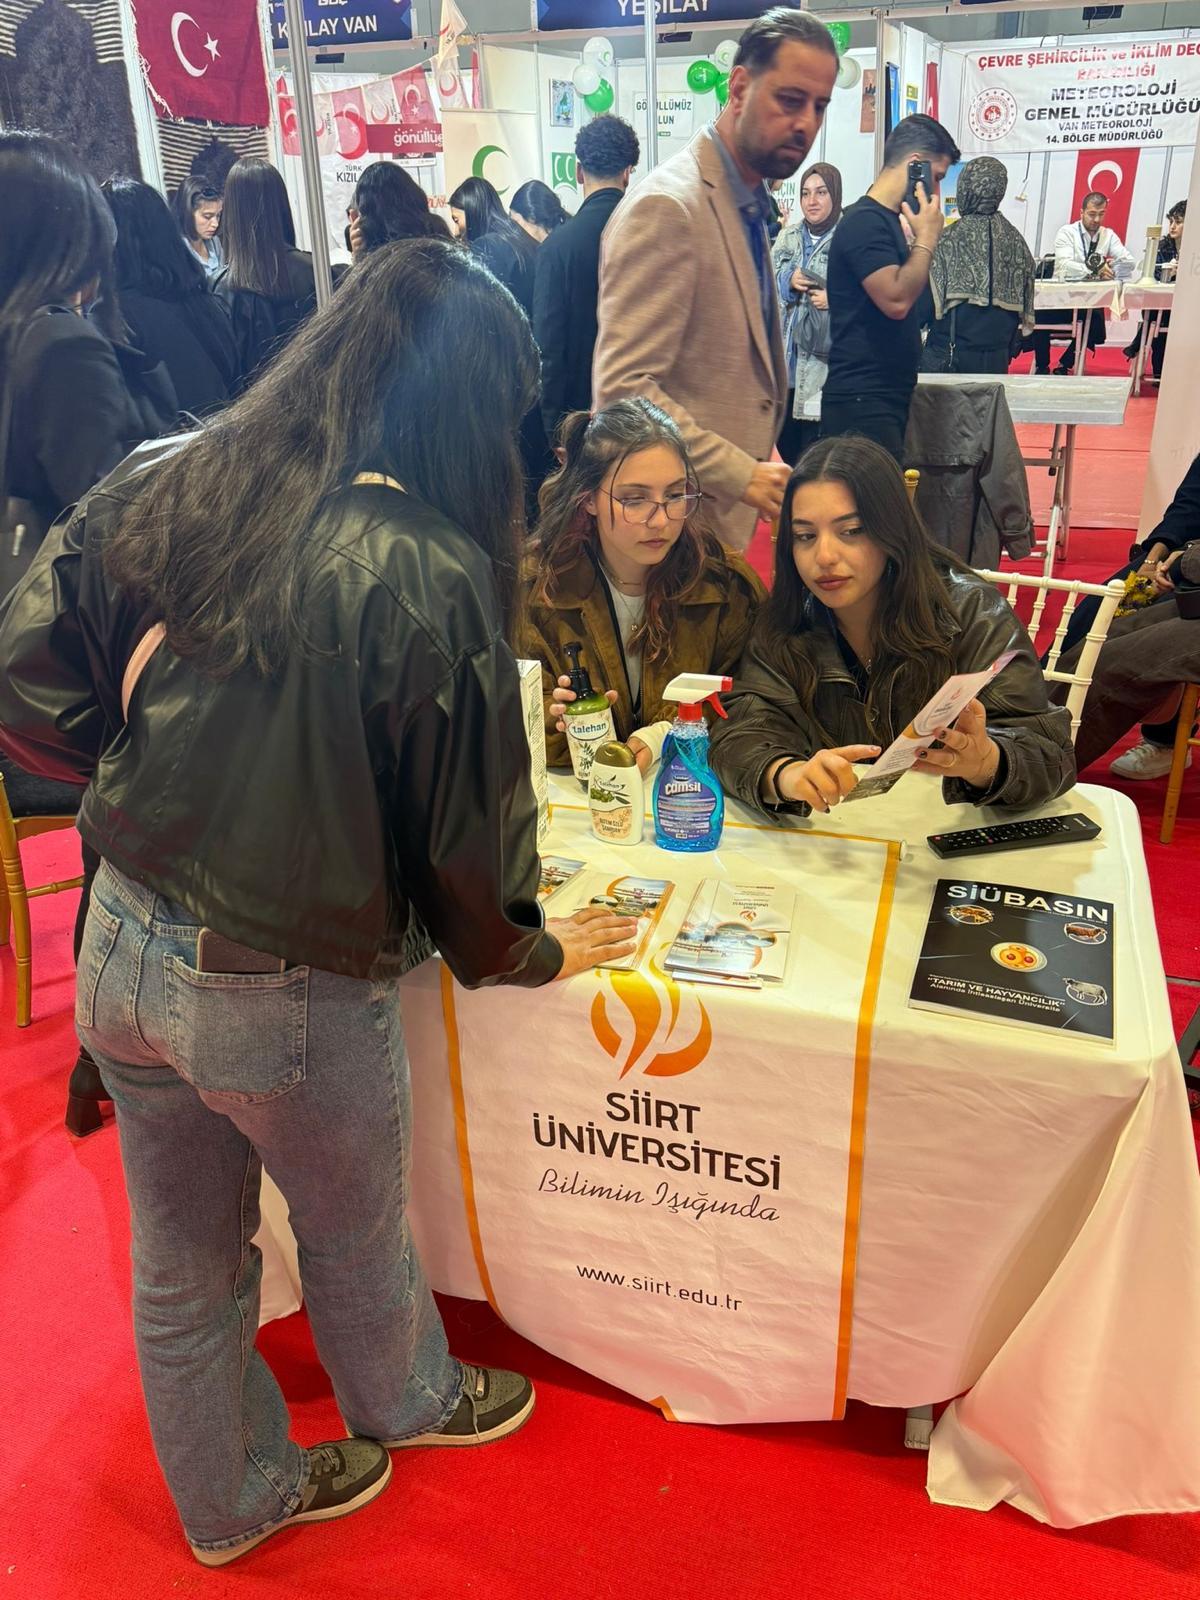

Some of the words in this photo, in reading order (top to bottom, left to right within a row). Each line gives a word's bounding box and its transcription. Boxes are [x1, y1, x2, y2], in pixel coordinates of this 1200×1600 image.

[343, 15, 377, 33] VAN
[978, 55, 1023, 71] ÇEVRE
[1027, 47, 1107, 68] ŞEHİRCİLİK
[1112, 52, 1127, 60] ve
[1131, 43, 1172, 59] İKLİM
[1051, 79, 1177, 101] METEOROLOJİ
[1024, 106, 1080, 121] GENEL
[1058, 121, 1079, 131] VAN
[1081, 116, 1152, 130] METEOROLOJİ
[1046, 134, 1060, 144] 14.
[1063, 131, 1096, 143] BÖLGE
[1098, 128, 1163, 142] MÜDÜRLÜĞÜ
[947, 884, 1108, 922] SİÜBASIN
[968, 981, 983, 992] VE
[606, 1089, 701, 1133] SİİRT
[533, 1112, 781, 1190] ÜNİVERSİTESİ
[538, 1168, 645, 1204] Bilimin
[651, 1181, 780, 1221] Işığında
[576, 1265, 743, 1311] www.siirt.edu.tr
